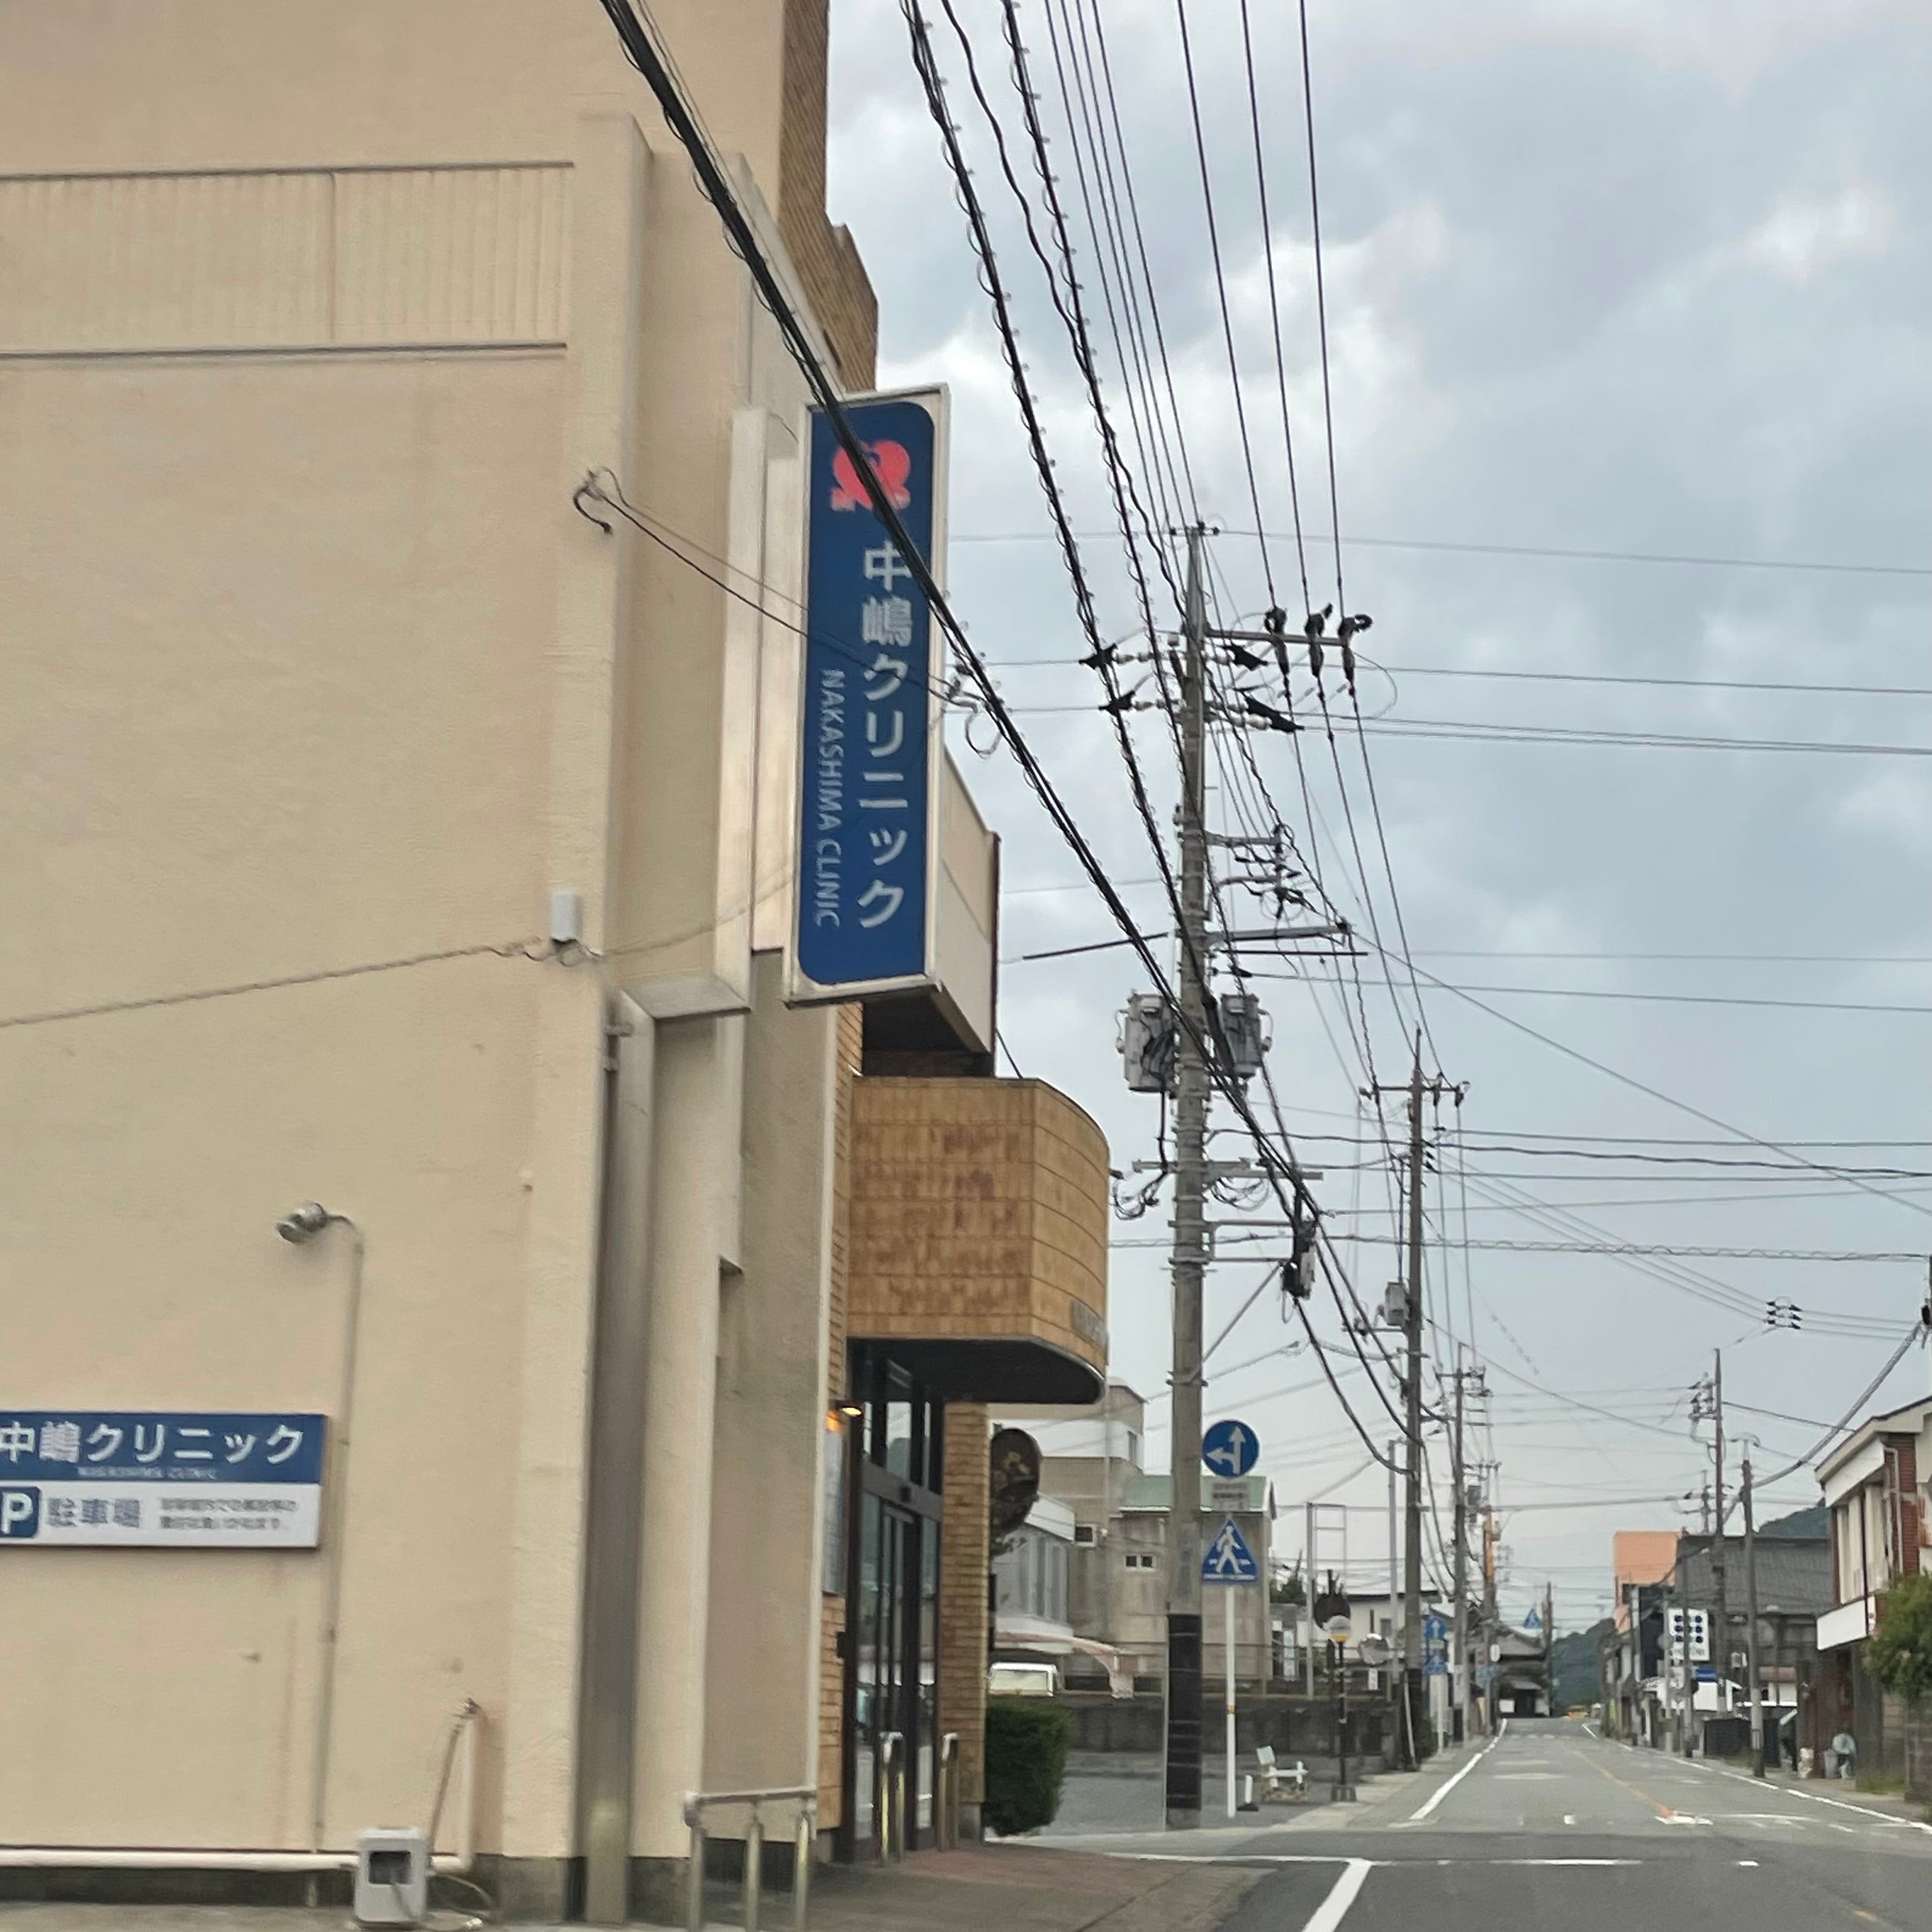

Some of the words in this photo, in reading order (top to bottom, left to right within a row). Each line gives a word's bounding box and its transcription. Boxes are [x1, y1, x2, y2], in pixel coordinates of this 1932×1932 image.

[818, 669, 845, 830] NAKASHIMA
[857, 540, 912, 928] 中嶋クリニック
[814, 838, 841, 927] CLINIC
[1, 1492, 33, 1533] P
